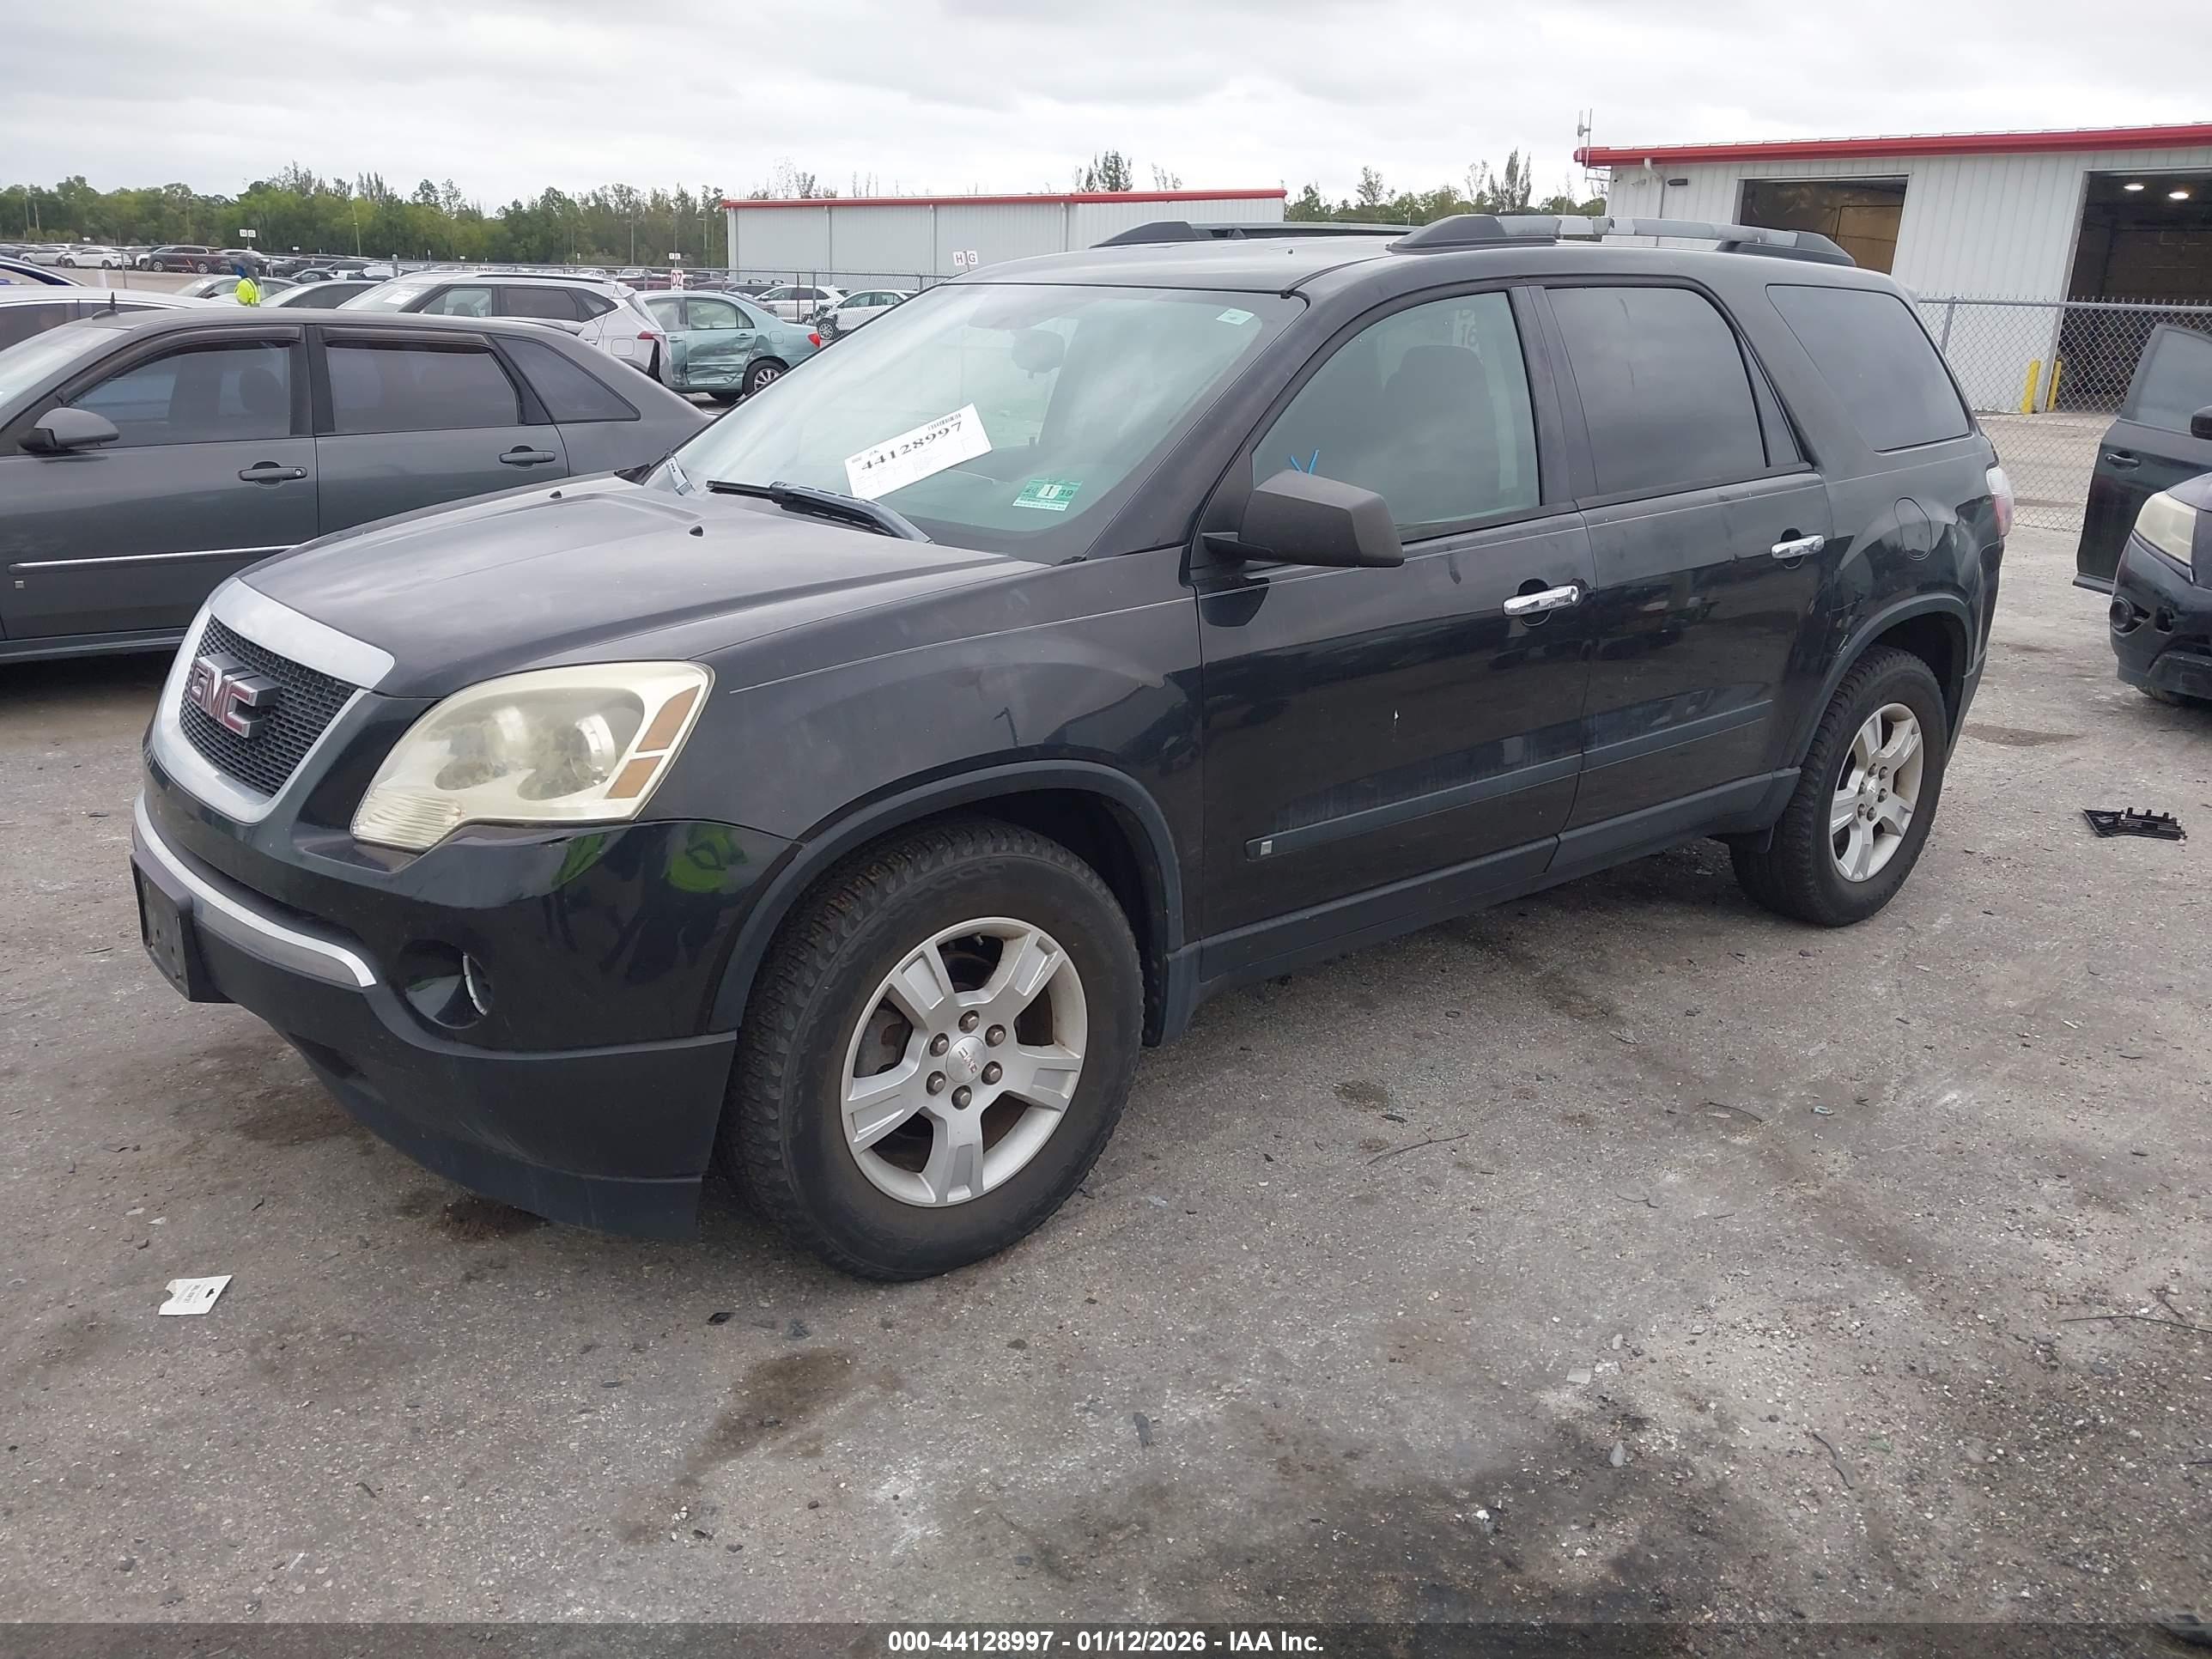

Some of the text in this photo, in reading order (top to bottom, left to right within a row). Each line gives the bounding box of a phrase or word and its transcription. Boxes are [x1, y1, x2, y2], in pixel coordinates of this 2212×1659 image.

[955, 252, 976, 264] H G
[672, 272, 683, 287] DZ
[860, 421, 963, 471] 44128997
[188, 656, 258, 738] GMC
